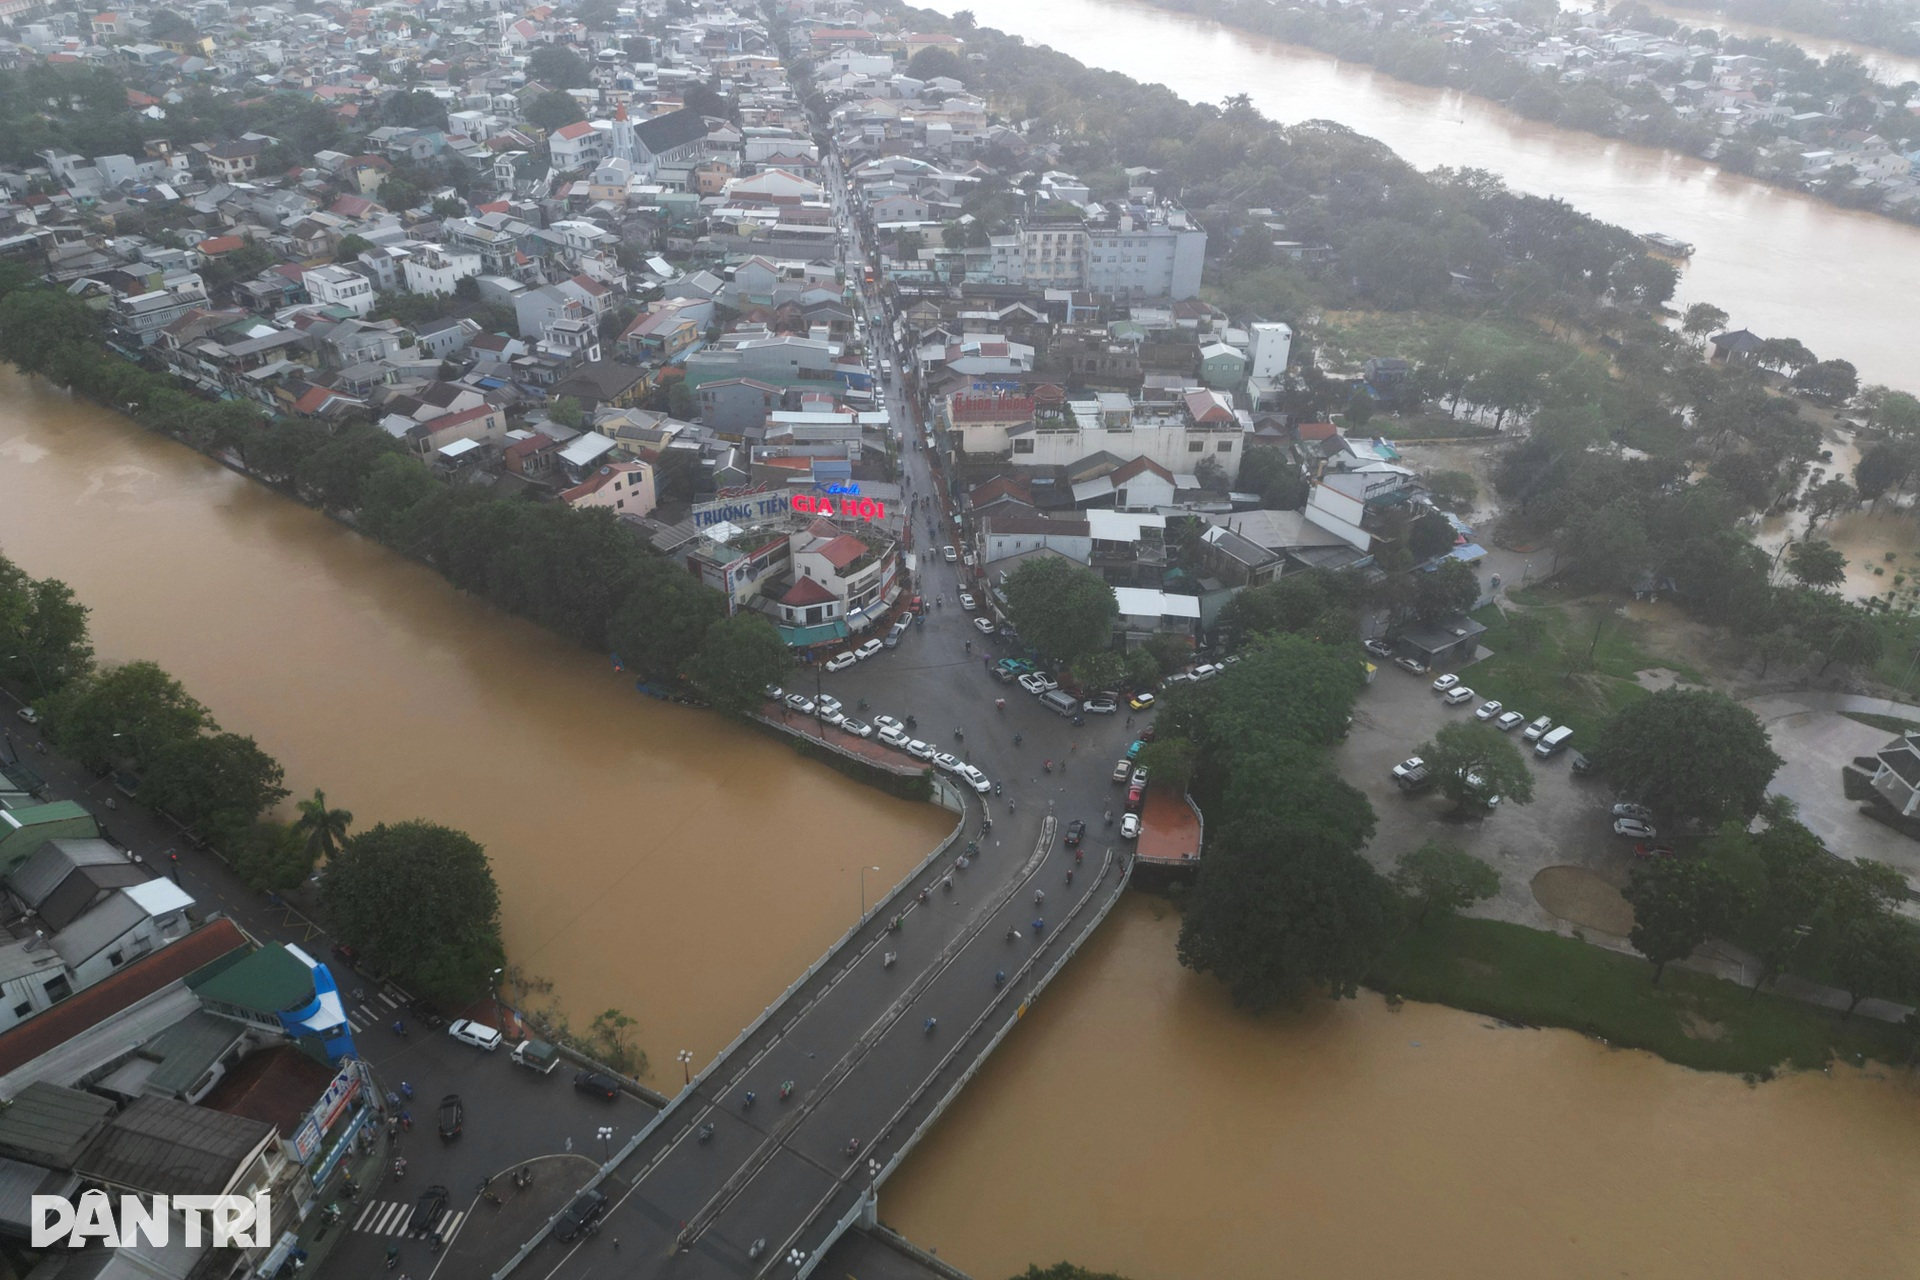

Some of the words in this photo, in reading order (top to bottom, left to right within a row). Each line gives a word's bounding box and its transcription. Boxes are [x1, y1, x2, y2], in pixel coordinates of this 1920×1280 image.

[693, 502, 752, 527] TRƯỜNG
[757, 492, 789, 516] TIỀN
[791, 494, 835, 516] GIA
[841, 497, 885, 523] HỘI
